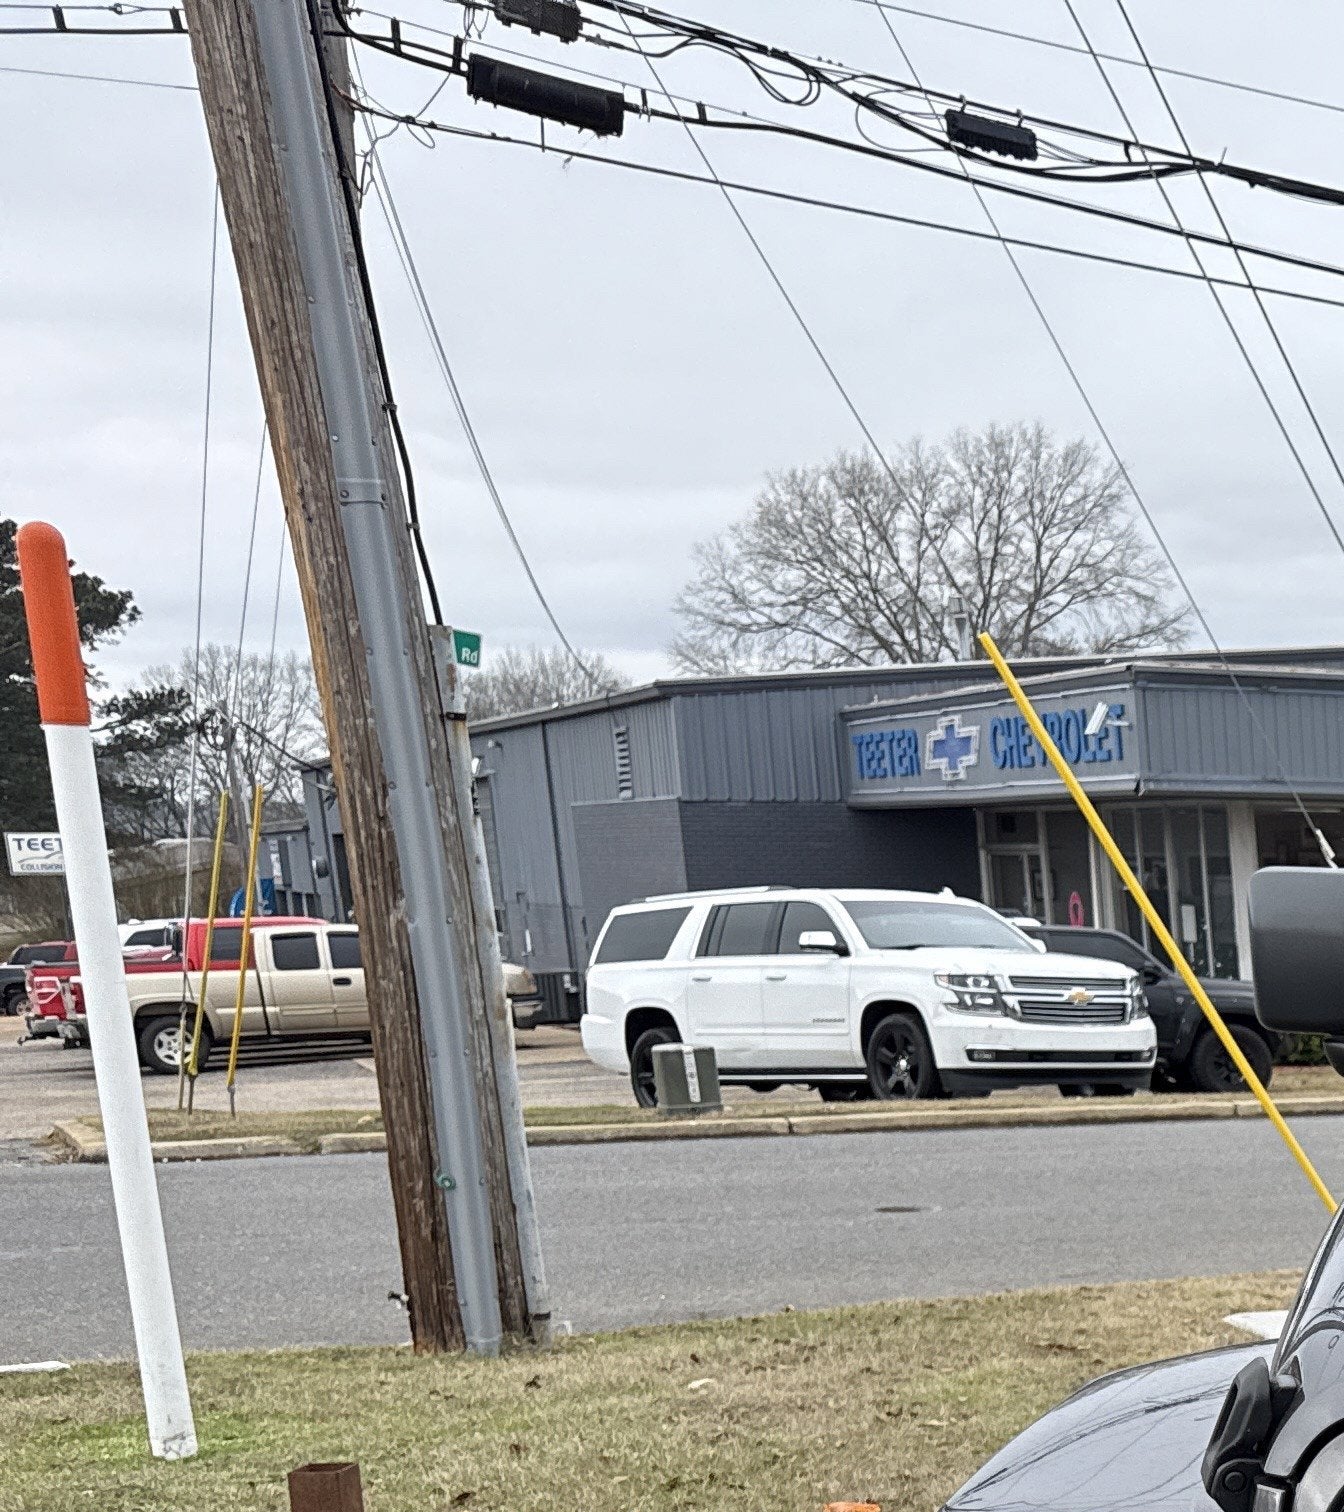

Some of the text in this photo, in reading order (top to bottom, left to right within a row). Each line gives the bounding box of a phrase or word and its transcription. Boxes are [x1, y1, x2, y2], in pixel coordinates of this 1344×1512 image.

[461, 647, 479, 664] Rd
[852, 728, 921, 780] TEETER
[12, 837, 63, 852] TEET
